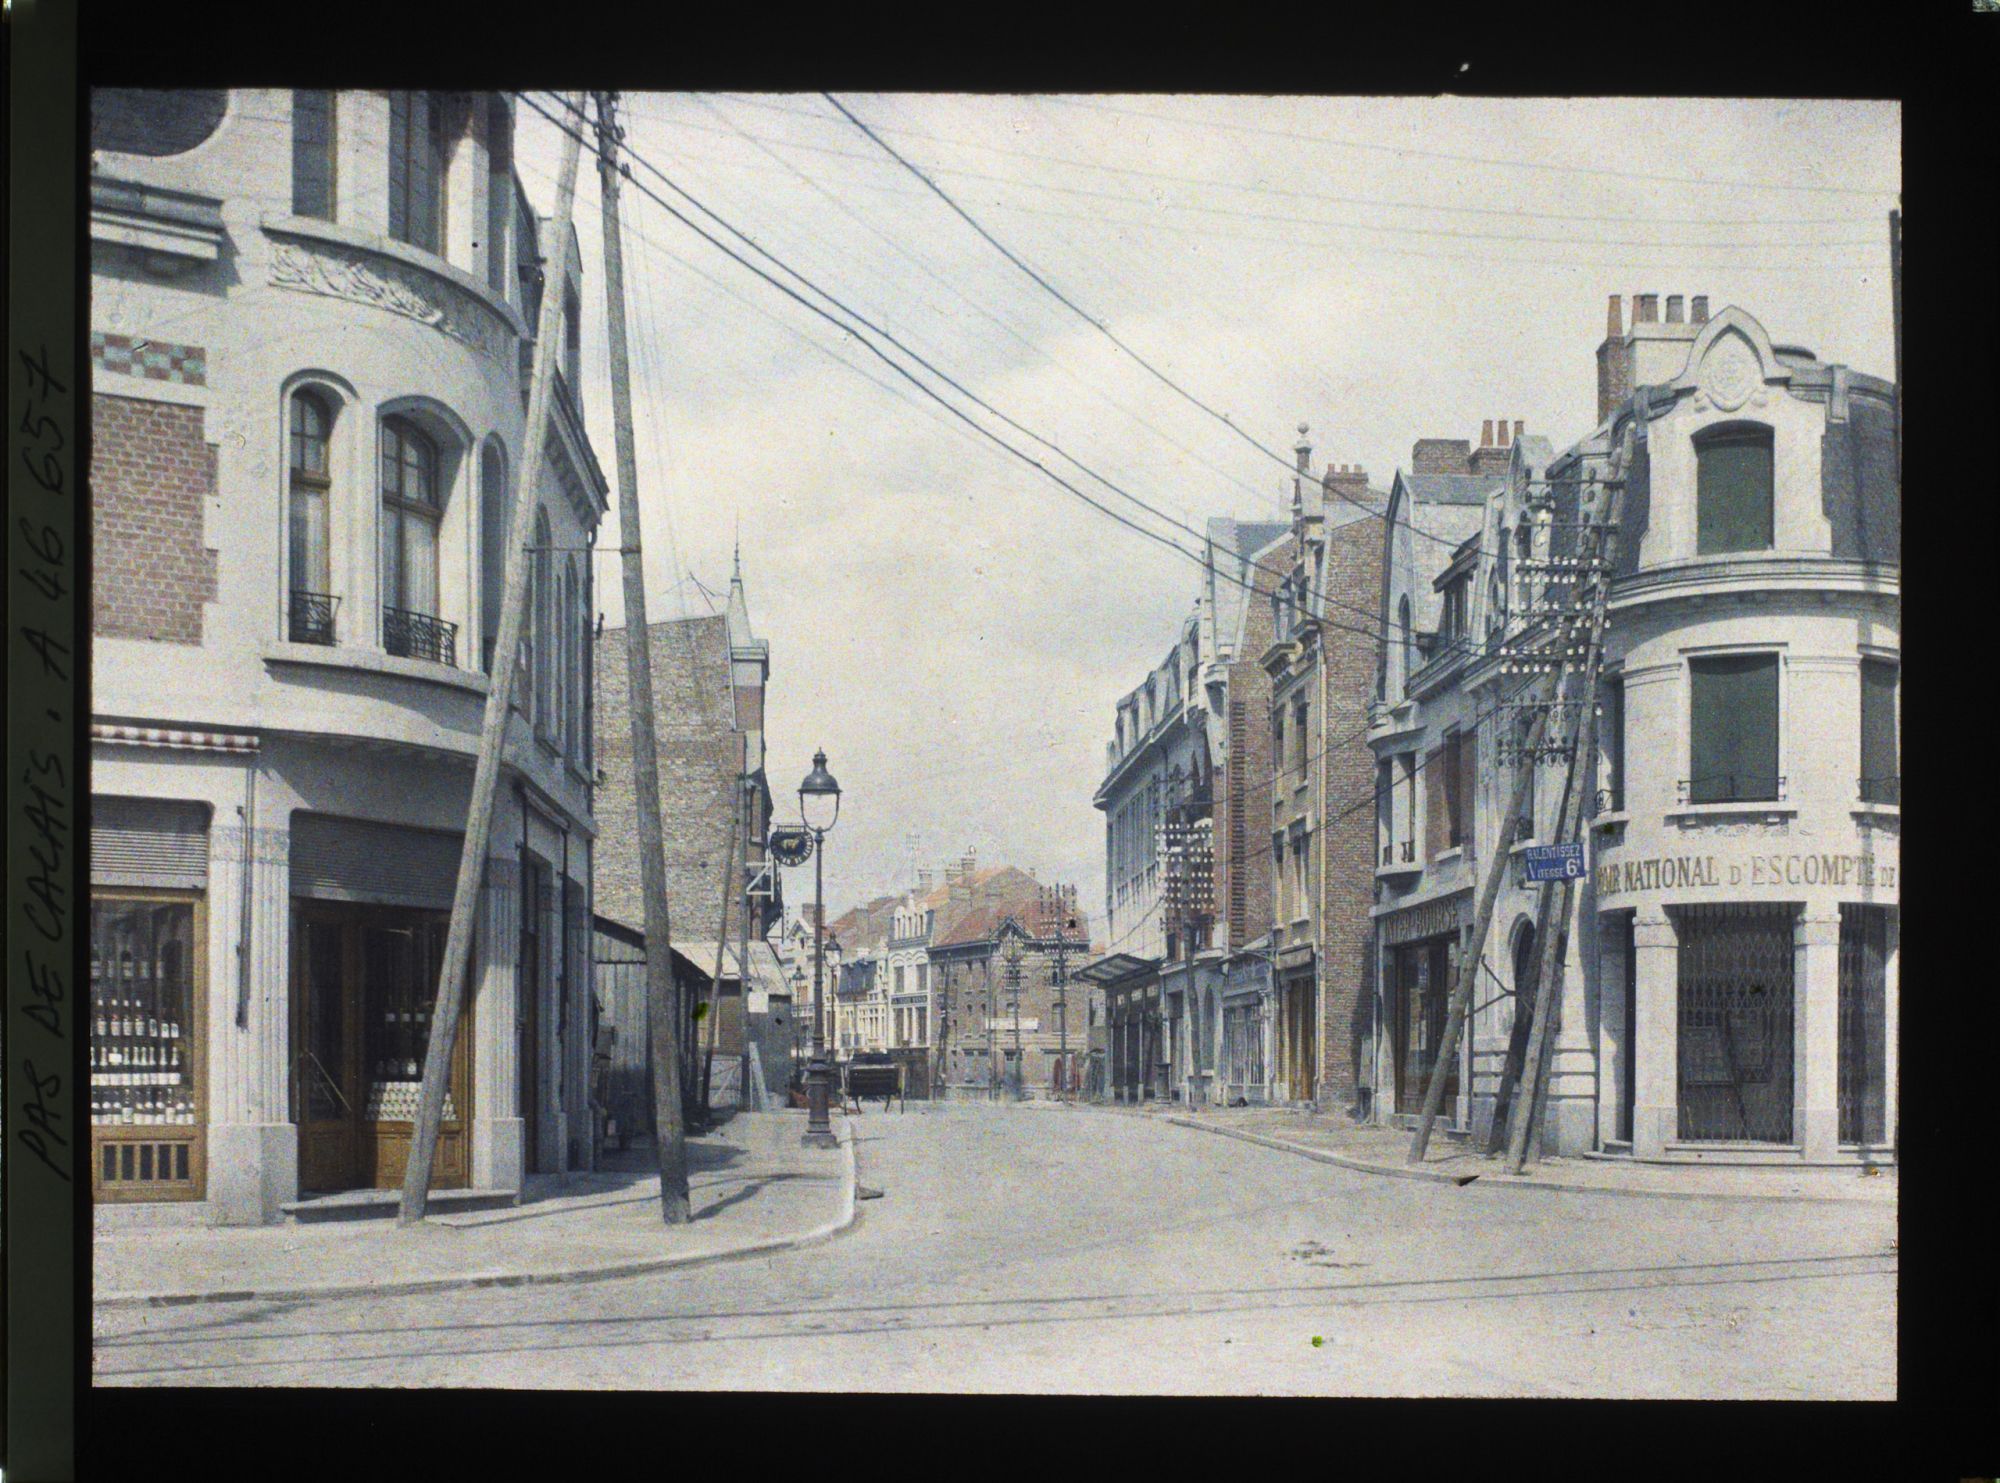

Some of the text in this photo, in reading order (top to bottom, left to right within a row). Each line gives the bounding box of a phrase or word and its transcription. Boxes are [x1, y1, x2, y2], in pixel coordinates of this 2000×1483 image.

[18, 342, 67, 494] 657
[19, 514, 68, 602] 46
[20, 618, 68, 682] A
[1527, 845, 1581, 860] RALENTISSEZ
[1624, 855, 1719, 892] NATIONAL
[21, 956, 66, 1042] DE
[18, 1060, 68, 1183] PAS
